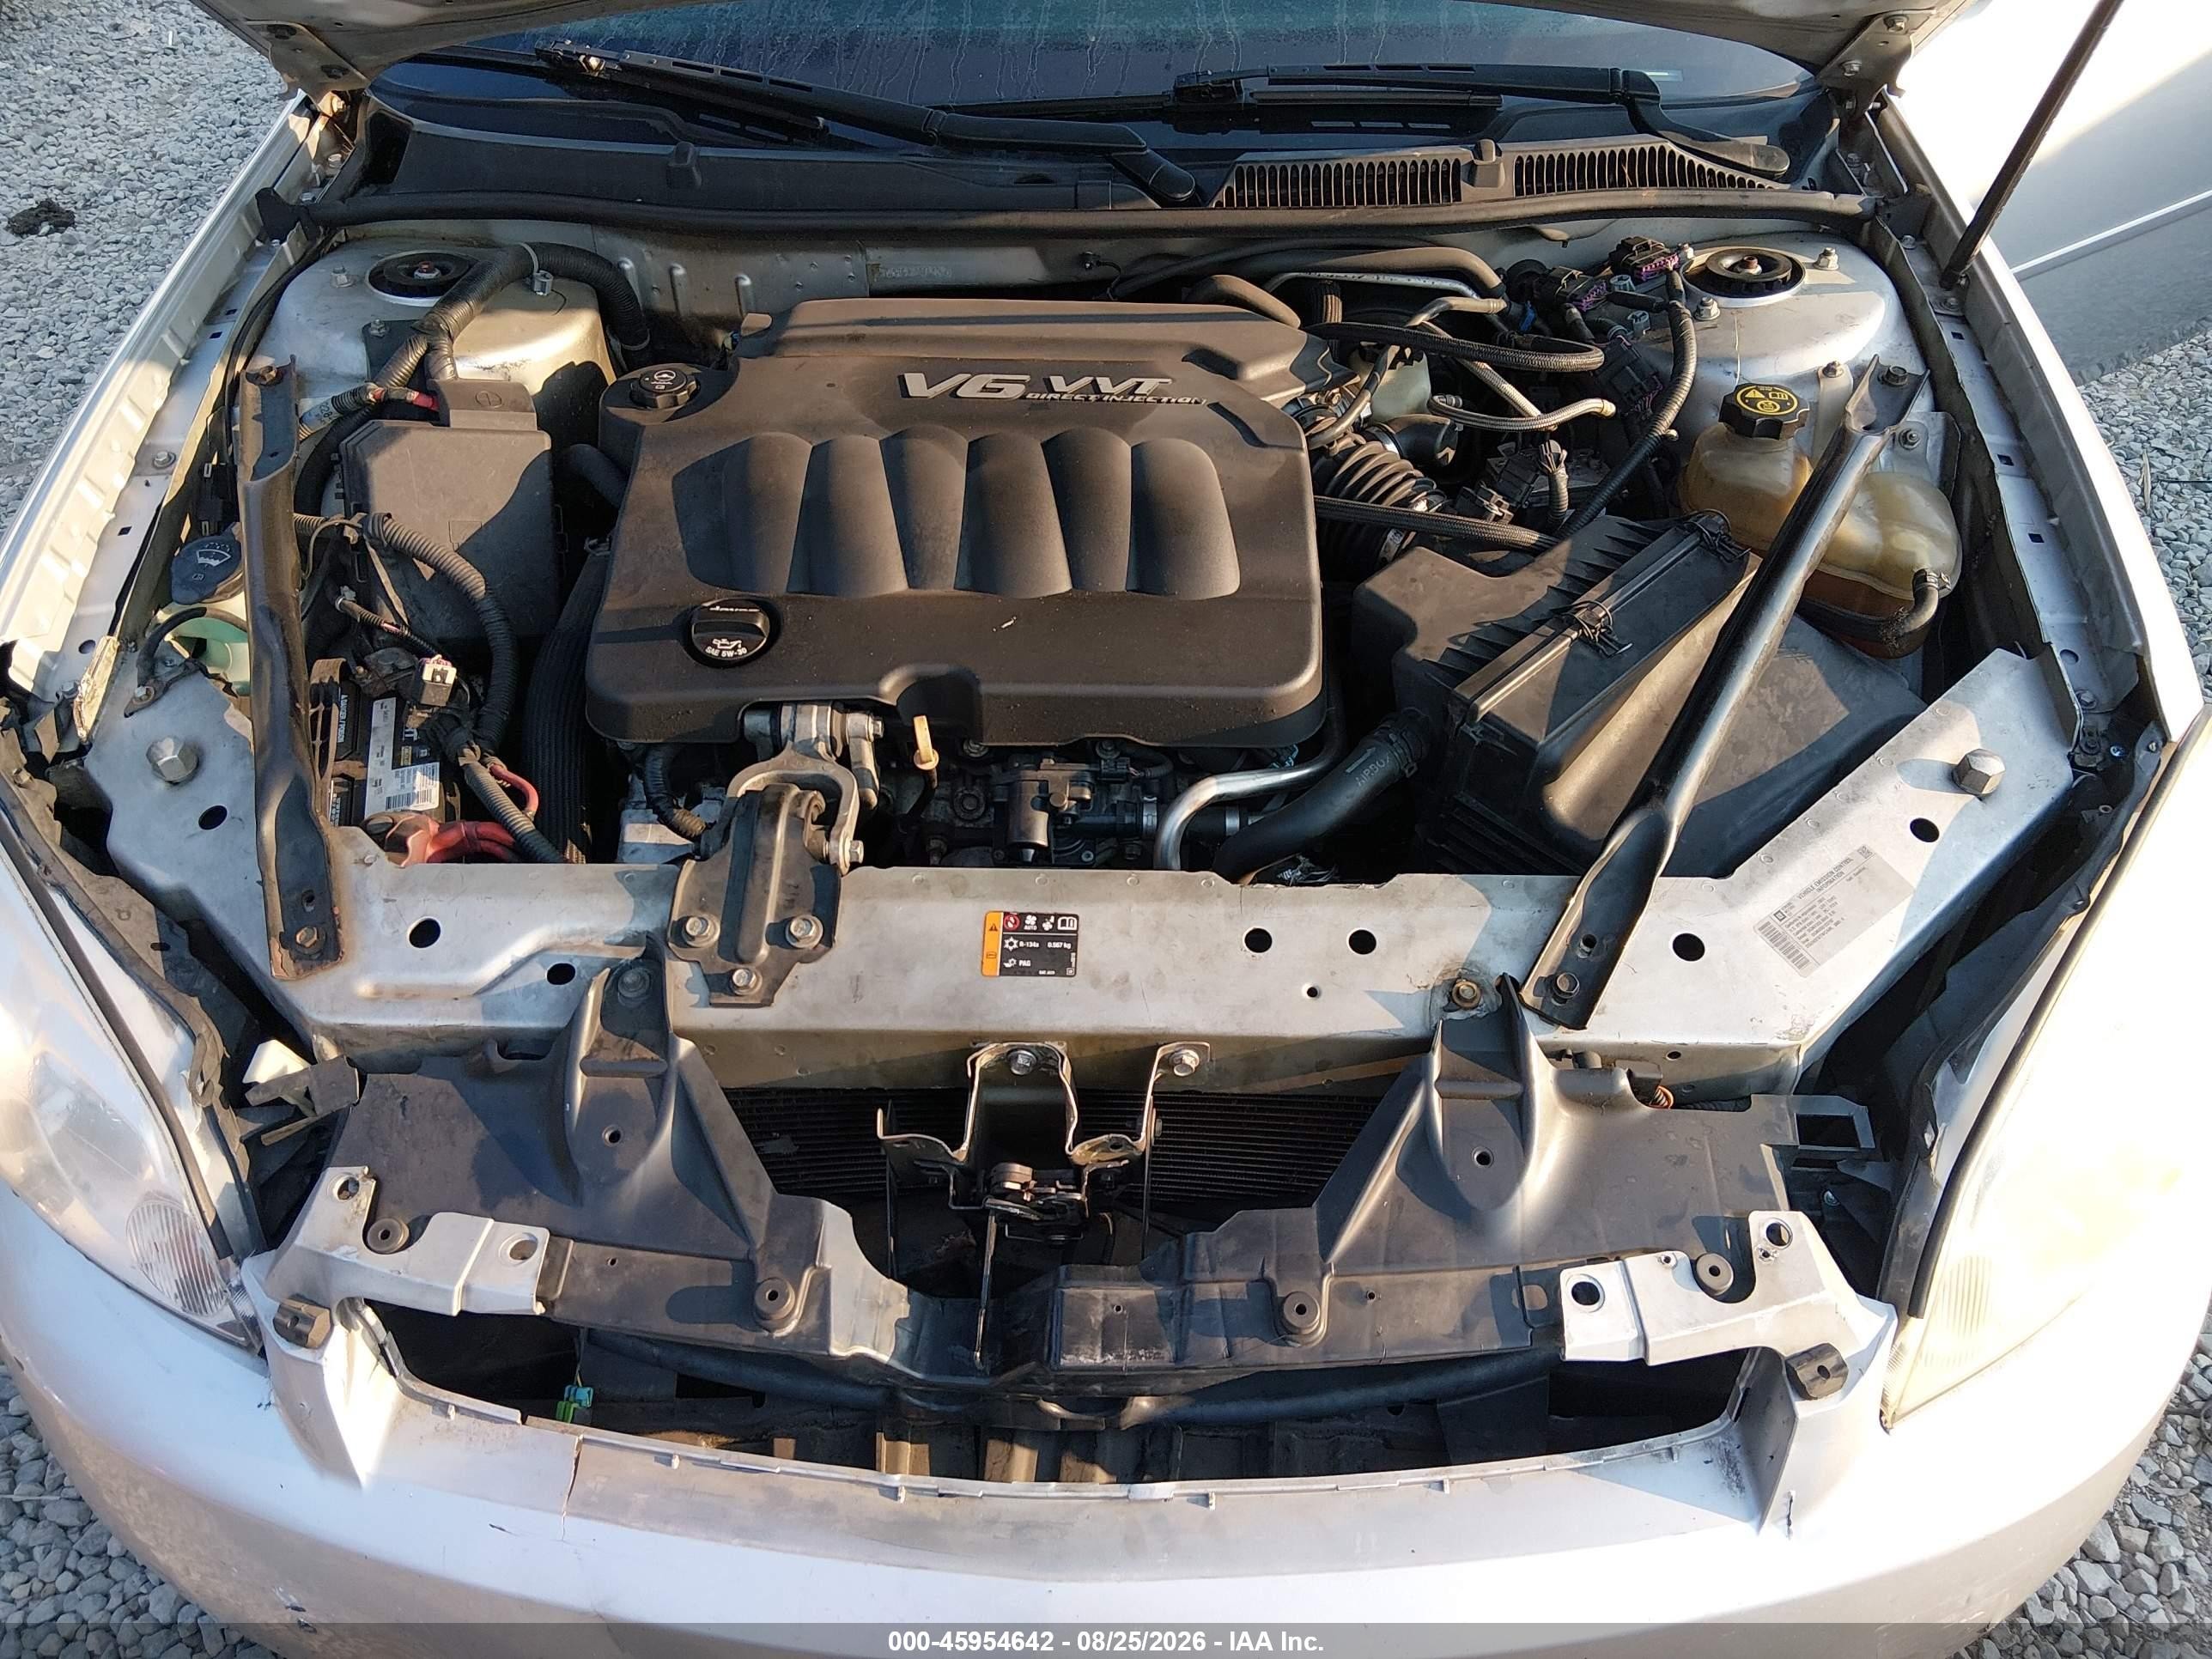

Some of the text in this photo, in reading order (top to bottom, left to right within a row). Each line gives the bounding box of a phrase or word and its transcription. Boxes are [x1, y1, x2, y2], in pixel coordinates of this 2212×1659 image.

[903, 373, 1172, 398] V6 VVT
[1026, 392, 1206, 404] DIRECT INJECTION
[705, 646, 747, 657] SAE 5W-30
[1797, 884, 1815, 900] VEHICLE
[1063, 941, 1072, 950] kg
